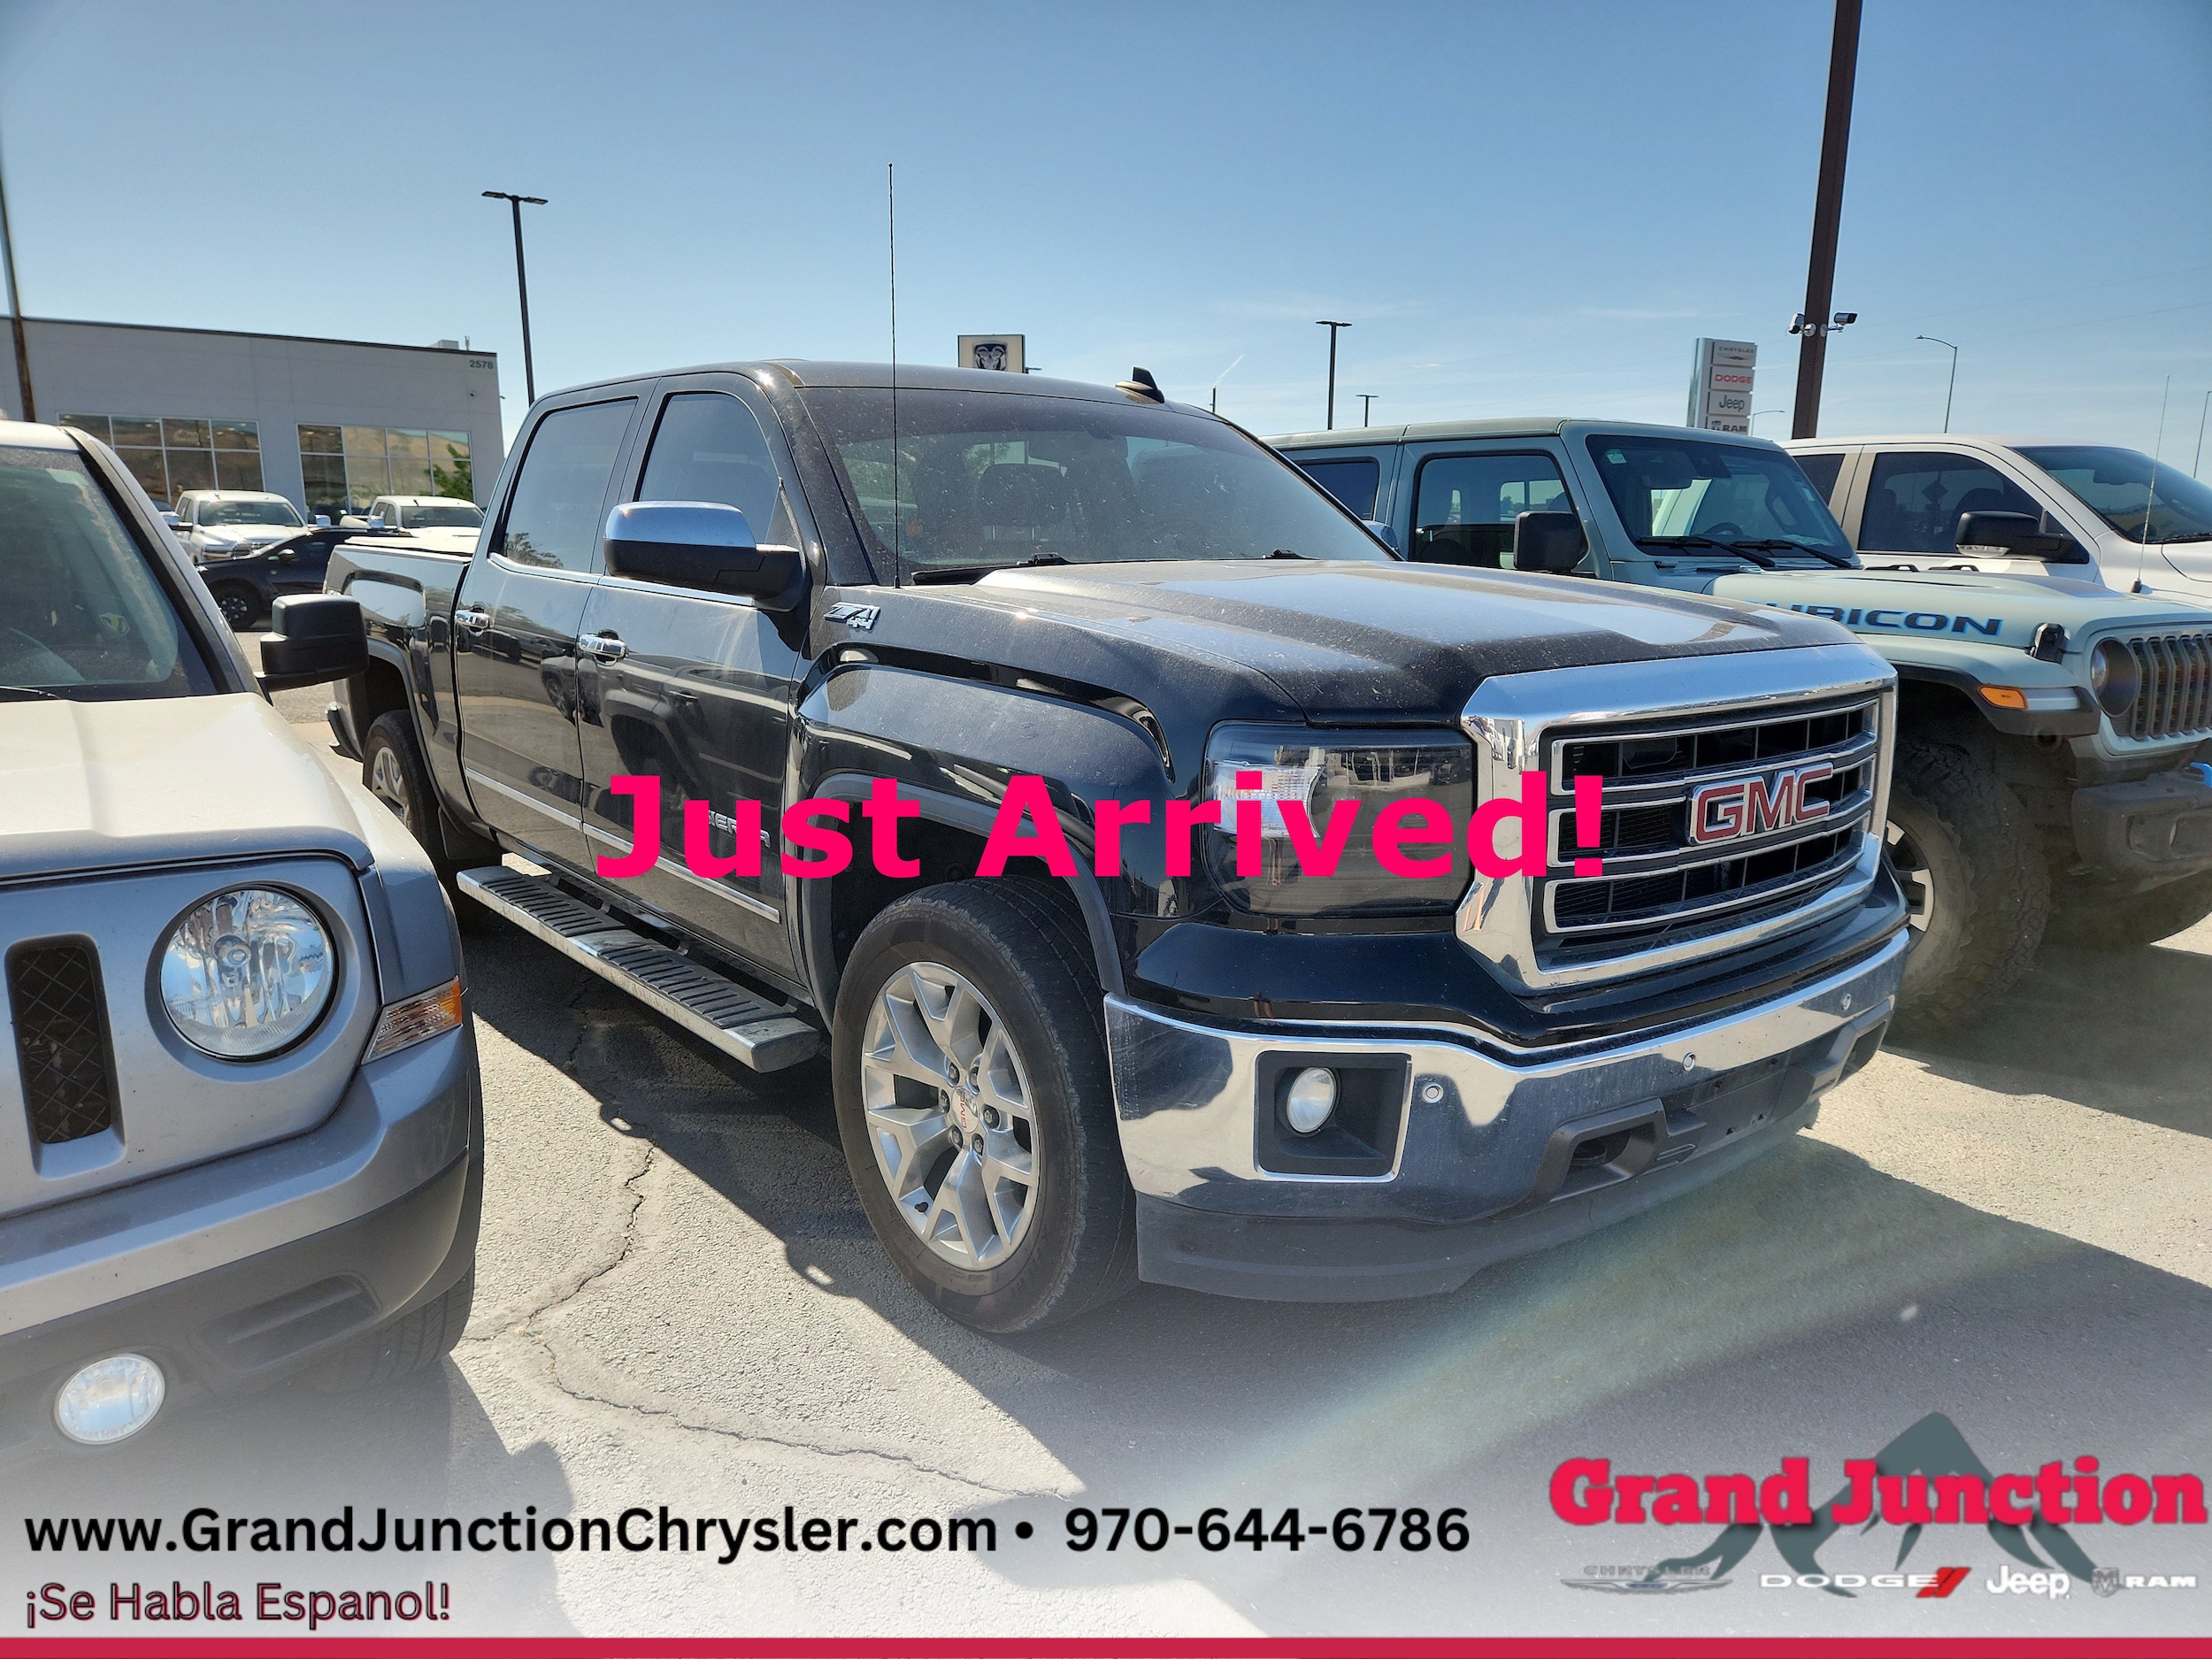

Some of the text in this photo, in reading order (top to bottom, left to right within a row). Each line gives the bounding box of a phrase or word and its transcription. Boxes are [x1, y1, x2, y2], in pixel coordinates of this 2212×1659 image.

[469, 359, 494, 369] 2578
[1716, 374, 1752, 383] DODGE
[1719, 395, 1745, 411] Jeep
[1746, 600, 2004, 636] BICON
[1690, 762, 1834, 845] GMC
